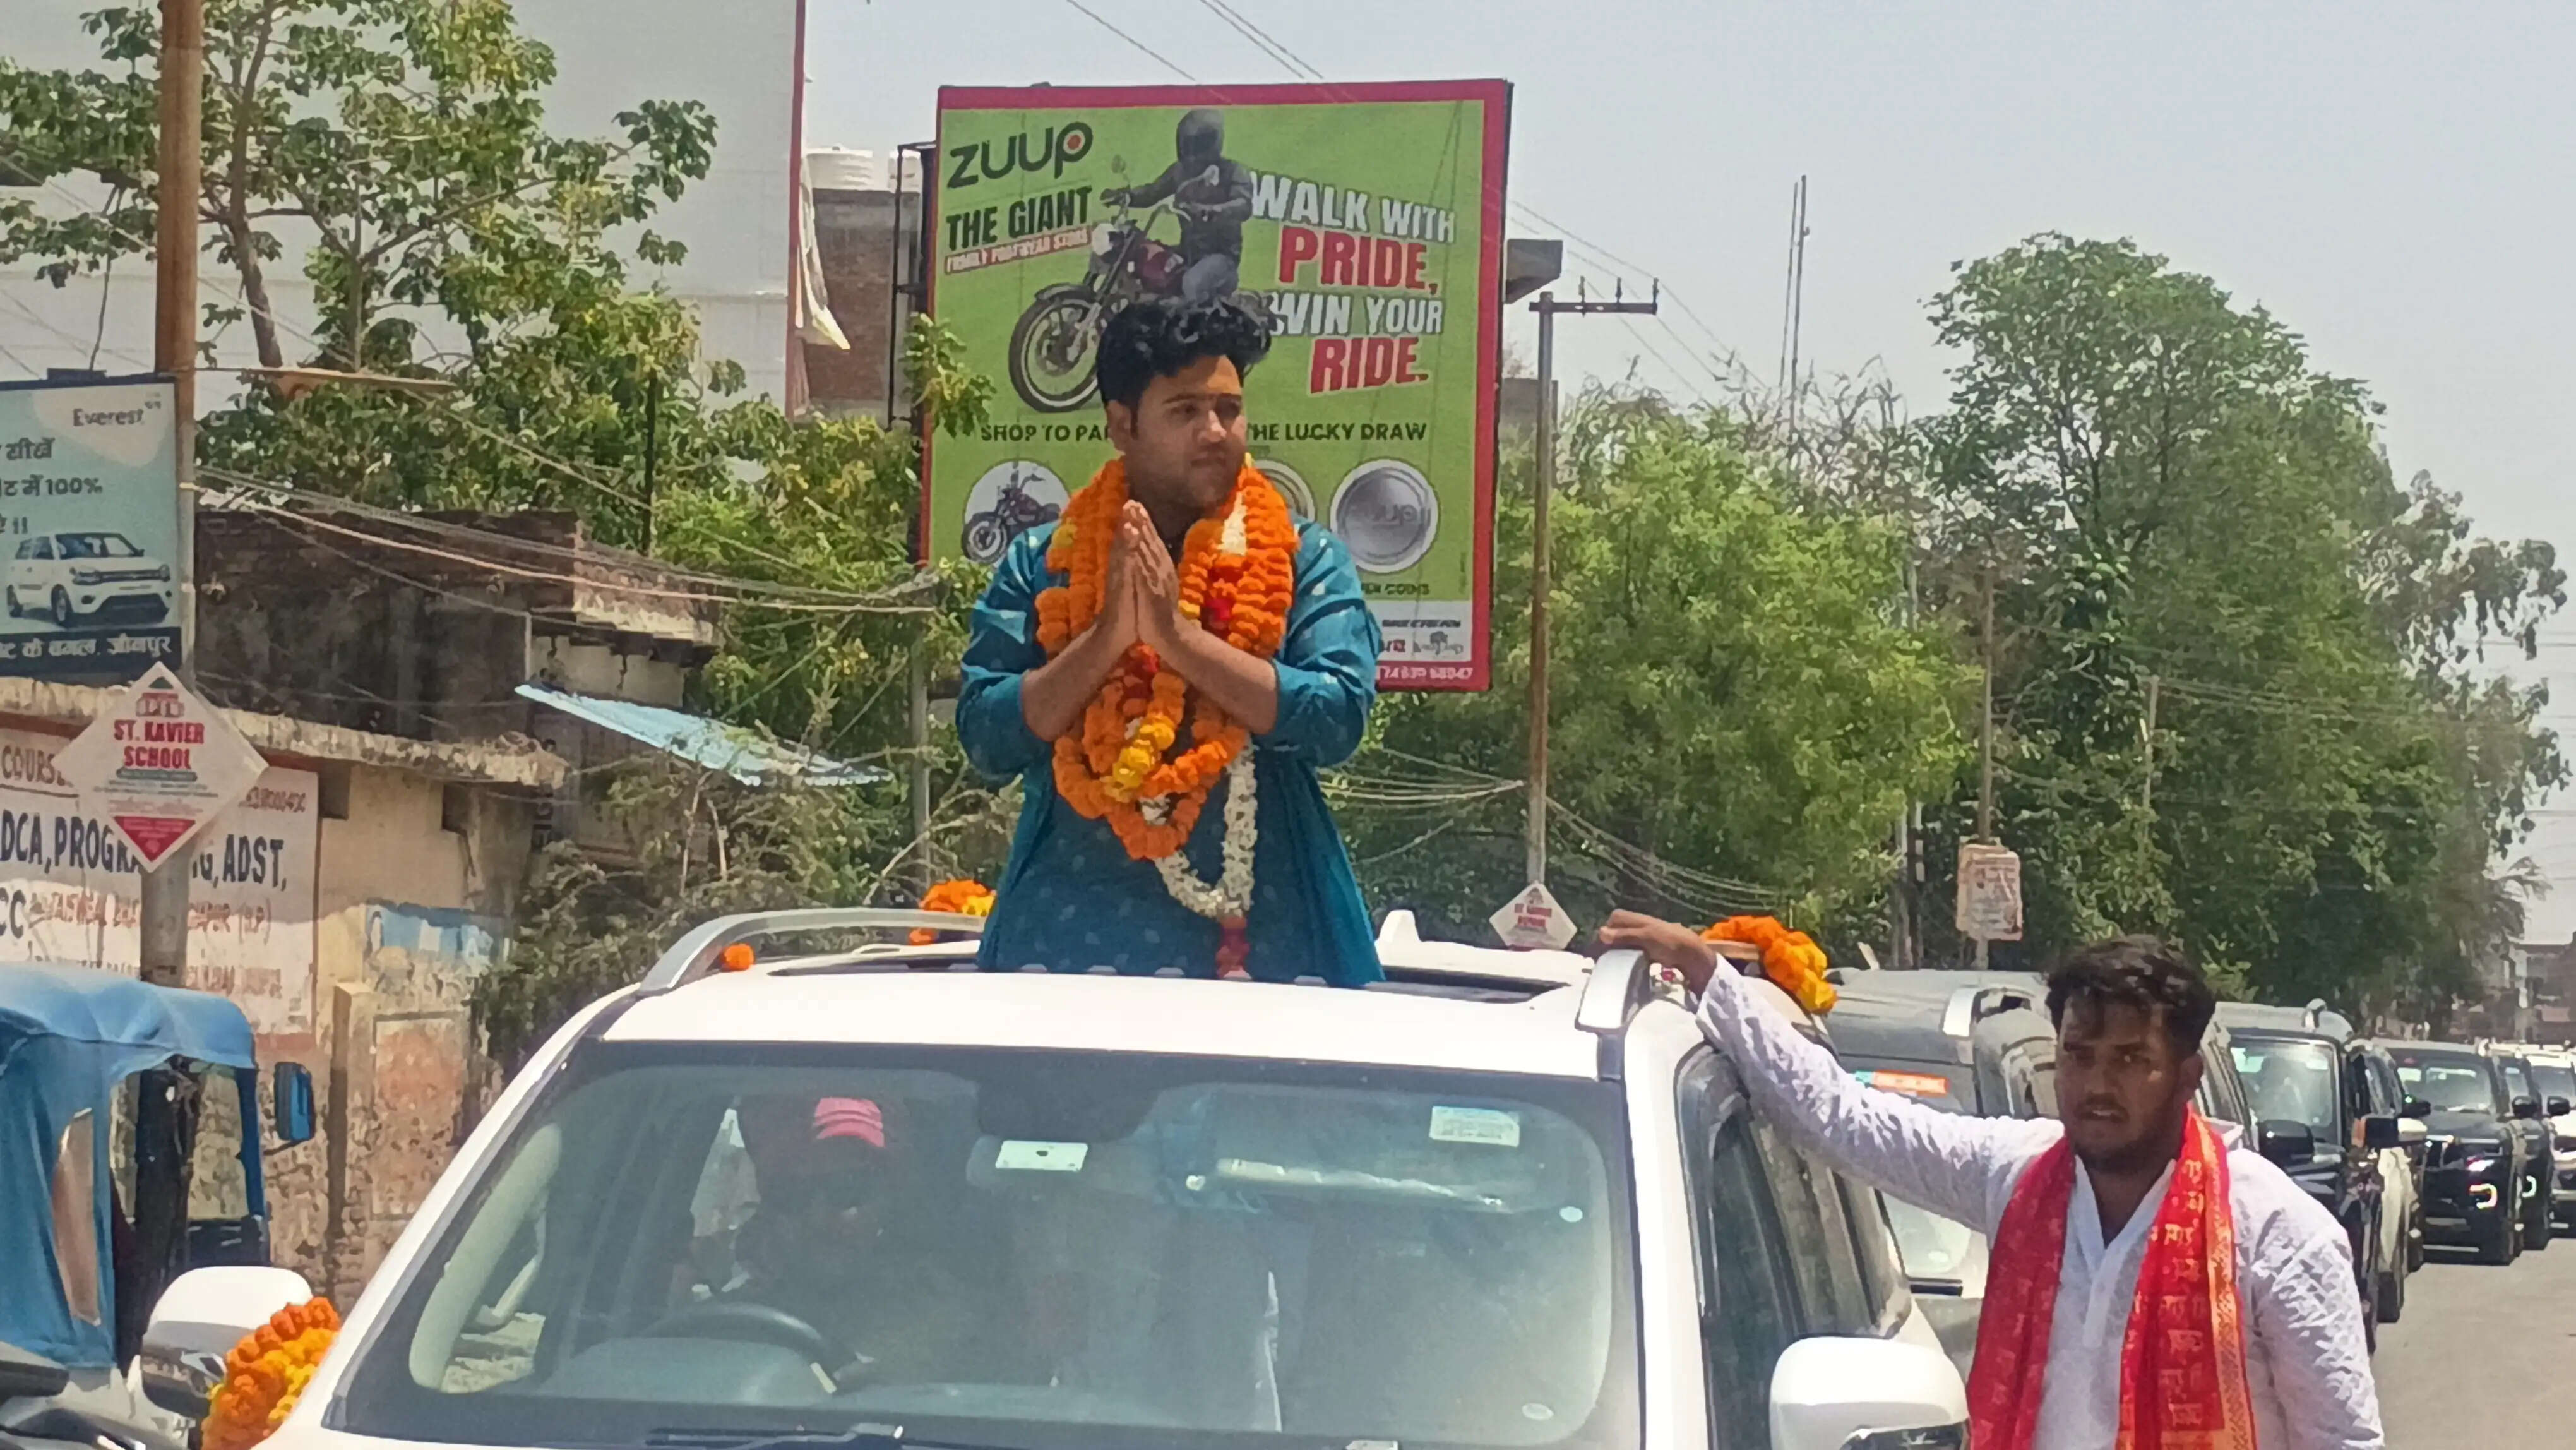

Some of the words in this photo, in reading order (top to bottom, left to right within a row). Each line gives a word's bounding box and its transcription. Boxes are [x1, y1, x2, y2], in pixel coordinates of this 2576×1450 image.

[946, 207, 998, 251] THE
[1008, 185, 1092, 239] GIANT
[1251, 171, 1369, 232] WALK
[1381, 198, 1455, 243] WITH
[1279, 225, 1438, 296] PRIDE,
[1268, 292, 1351, 336] WIN
[1366, 297, 1443, 335] YOUR
[1310, 337, 1429, 394] RIDE.
[981, 424, 1037, 441] SHOP
[1042, 424, 1071, 441] TO
[1285, 423, 1356, 441] LUCKY
[1361, 422, 1428, 441] DRAW
[45, 477, 104, 495] 100%
[114, 719, 140, 741] ST.
[144, 721, 205, 745] XAVIER
[124, 746, 192, 770] SCHOOL
[222, 834, 287, 892] ADST,
